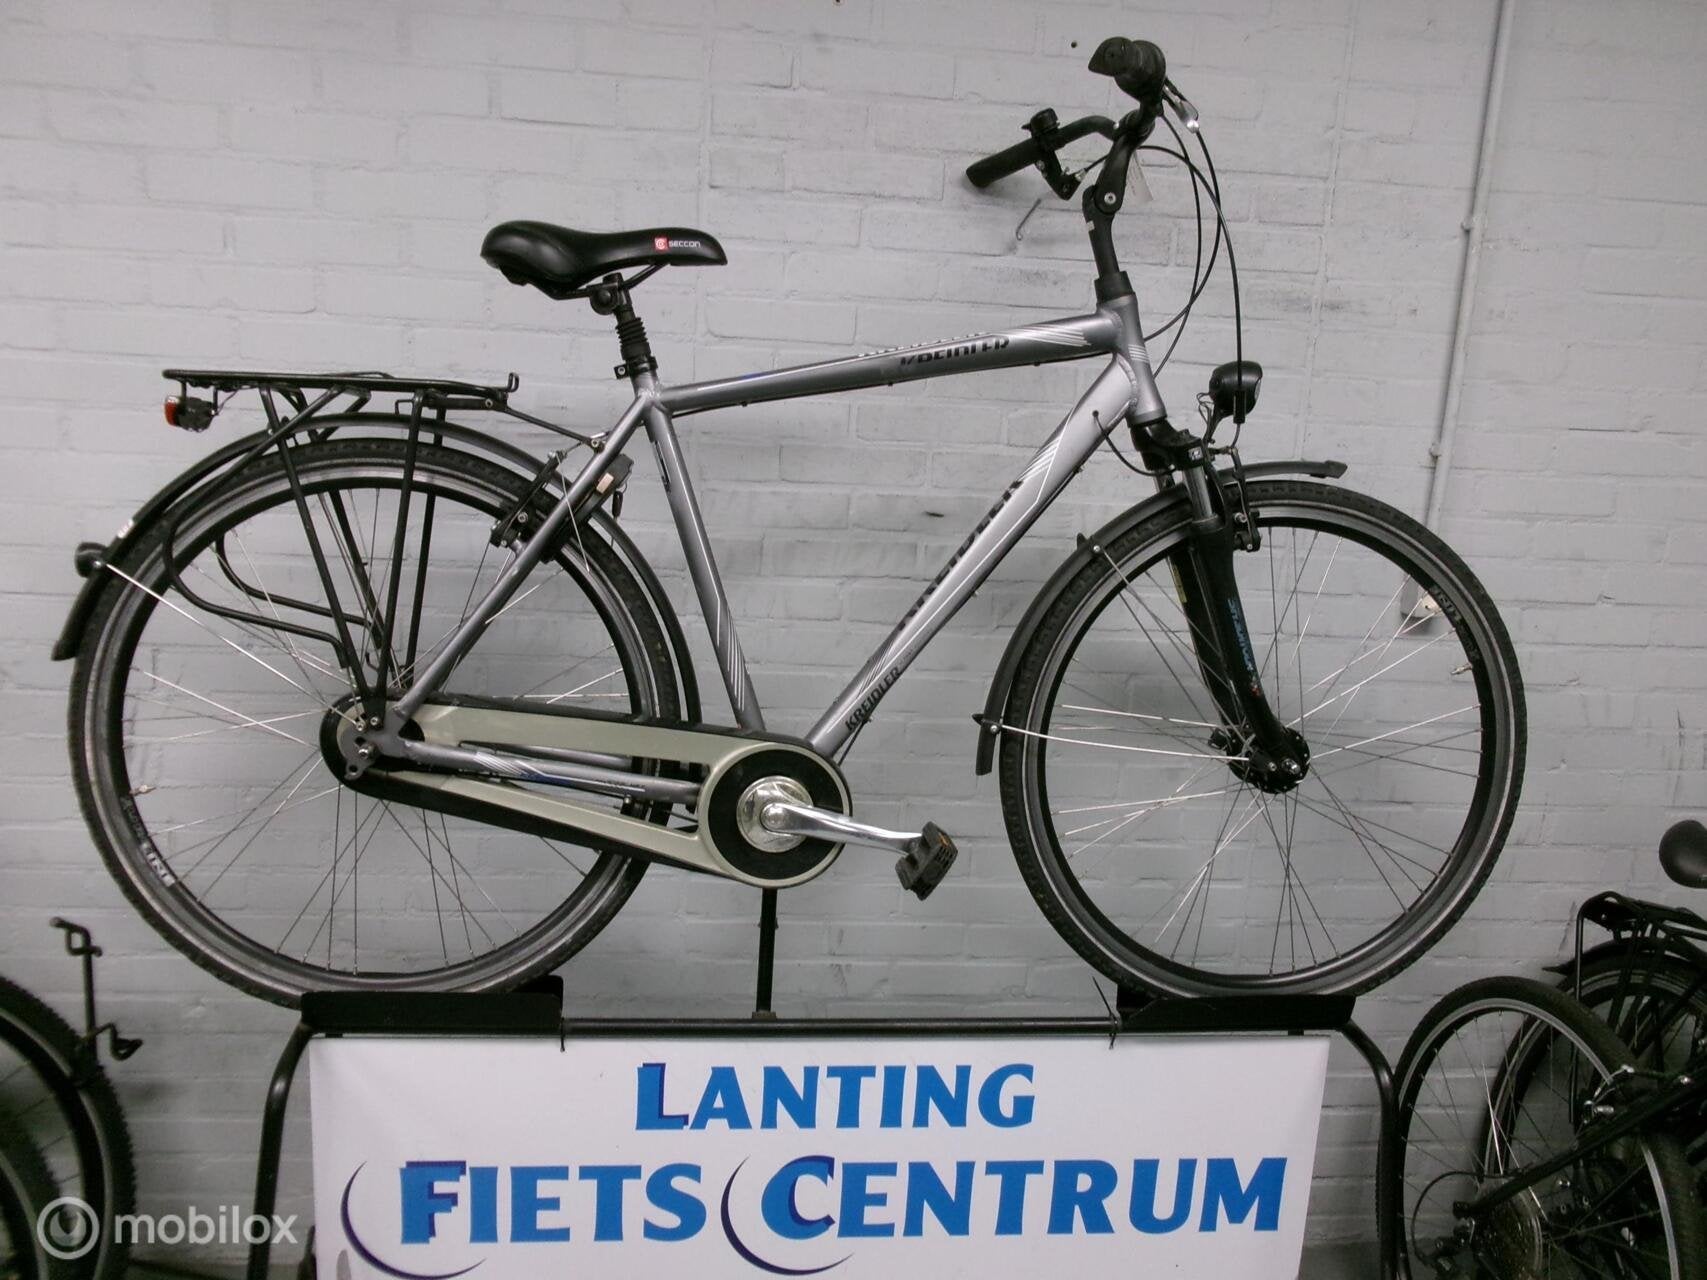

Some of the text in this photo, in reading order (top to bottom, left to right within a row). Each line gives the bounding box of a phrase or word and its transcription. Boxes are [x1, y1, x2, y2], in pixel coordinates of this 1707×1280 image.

[844, 666, 902, 732] KREIDLER
[637, 1063, 1035, 1131] LANTING
[401, 1155, 1287, 1244] FIETS CENTRUM
